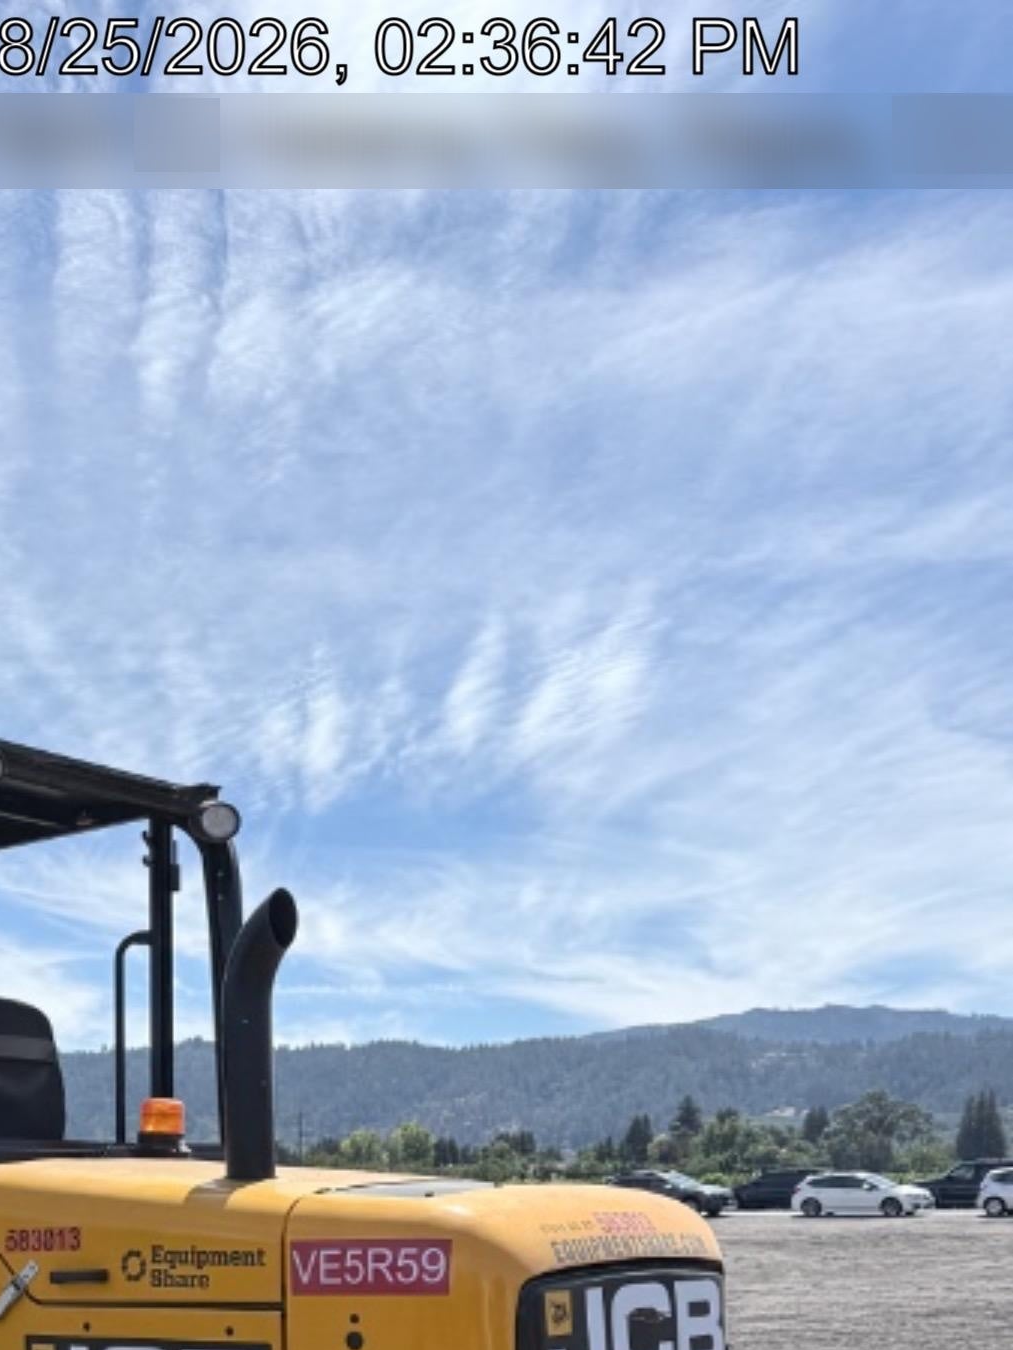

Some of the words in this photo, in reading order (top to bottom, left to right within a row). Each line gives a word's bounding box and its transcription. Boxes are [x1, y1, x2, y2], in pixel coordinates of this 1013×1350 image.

[150, 1244, 267, 1270] Equipment
[292, 1247, 448, 1285] VE5R59
[150, 1268, 210, 1290] Share
